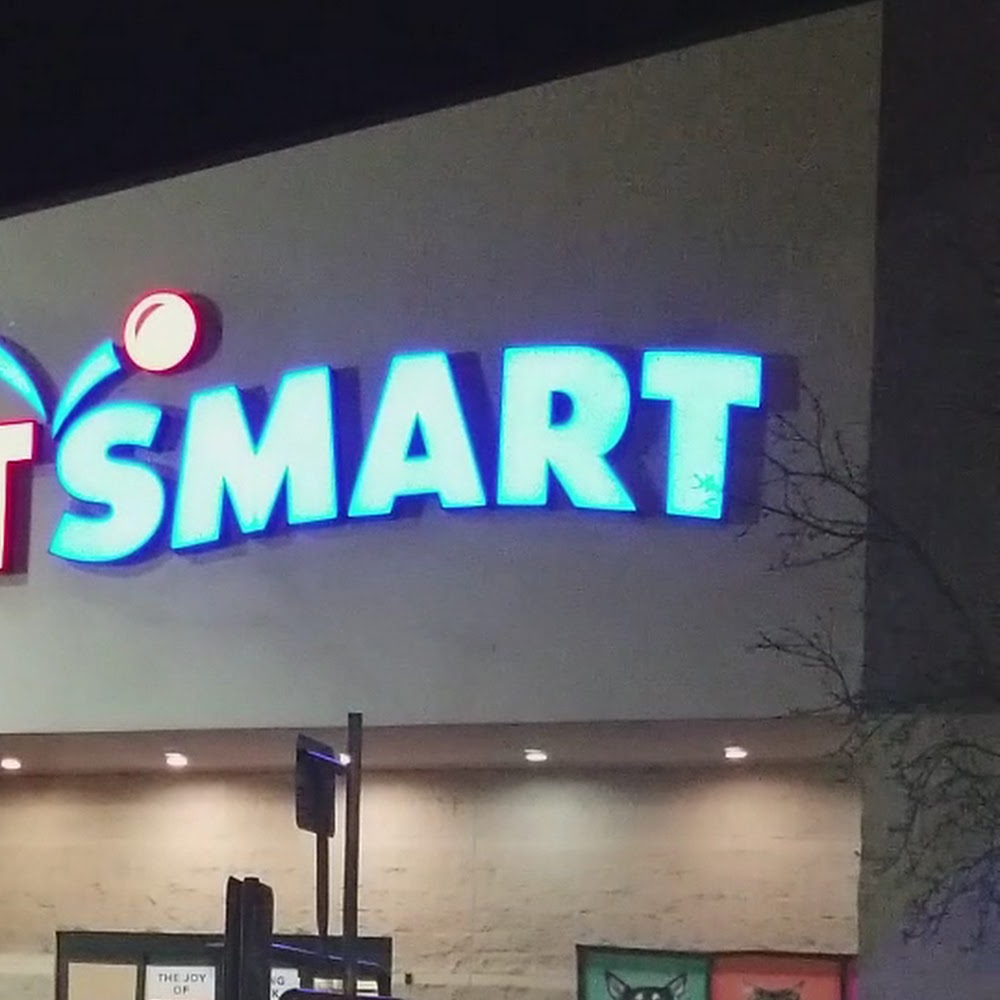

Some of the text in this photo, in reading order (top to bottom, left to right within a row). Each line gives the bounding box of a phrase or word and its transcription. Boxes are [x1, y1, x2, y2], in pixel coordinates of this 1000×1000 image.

[157, 973, 207, 984] THE JOY
[173, 985, 190, 996] OF
